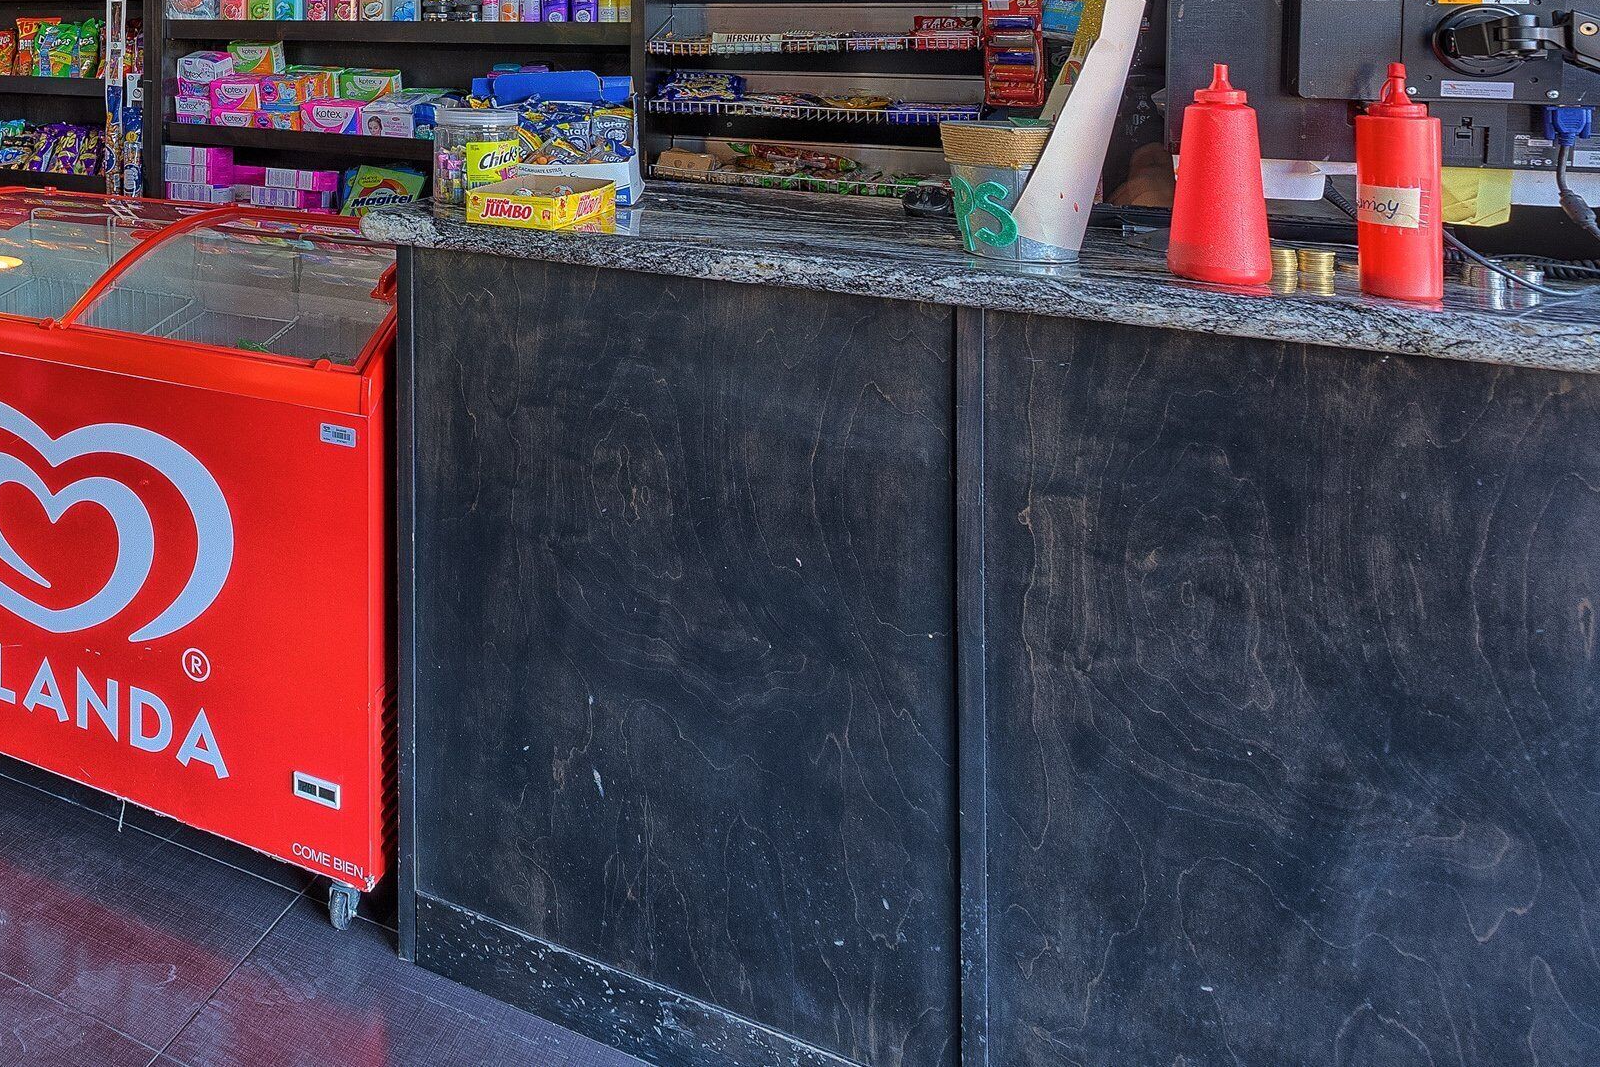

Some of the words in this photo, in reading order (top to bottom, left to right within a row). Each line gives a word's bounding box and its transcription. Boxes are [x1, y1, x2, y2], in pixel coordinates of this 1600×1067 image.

[726, 34, 771, 43] HERSHEY'S
[241, 48, 258, 56] kotex
[358, 77, 377, 86] kotex
[224, 85, 244, 94] kotex
[179, 102, 198, 111] kotex
[316, 107, 342, 119] kotex
[224, 114, 244, 123] kotex
[351, 193, 412, 208] Magitel
[481, 203, 533, 220] JUMBO
[292, 842, 331, 867] COME
[333, 856, 364, 879] BIEN
